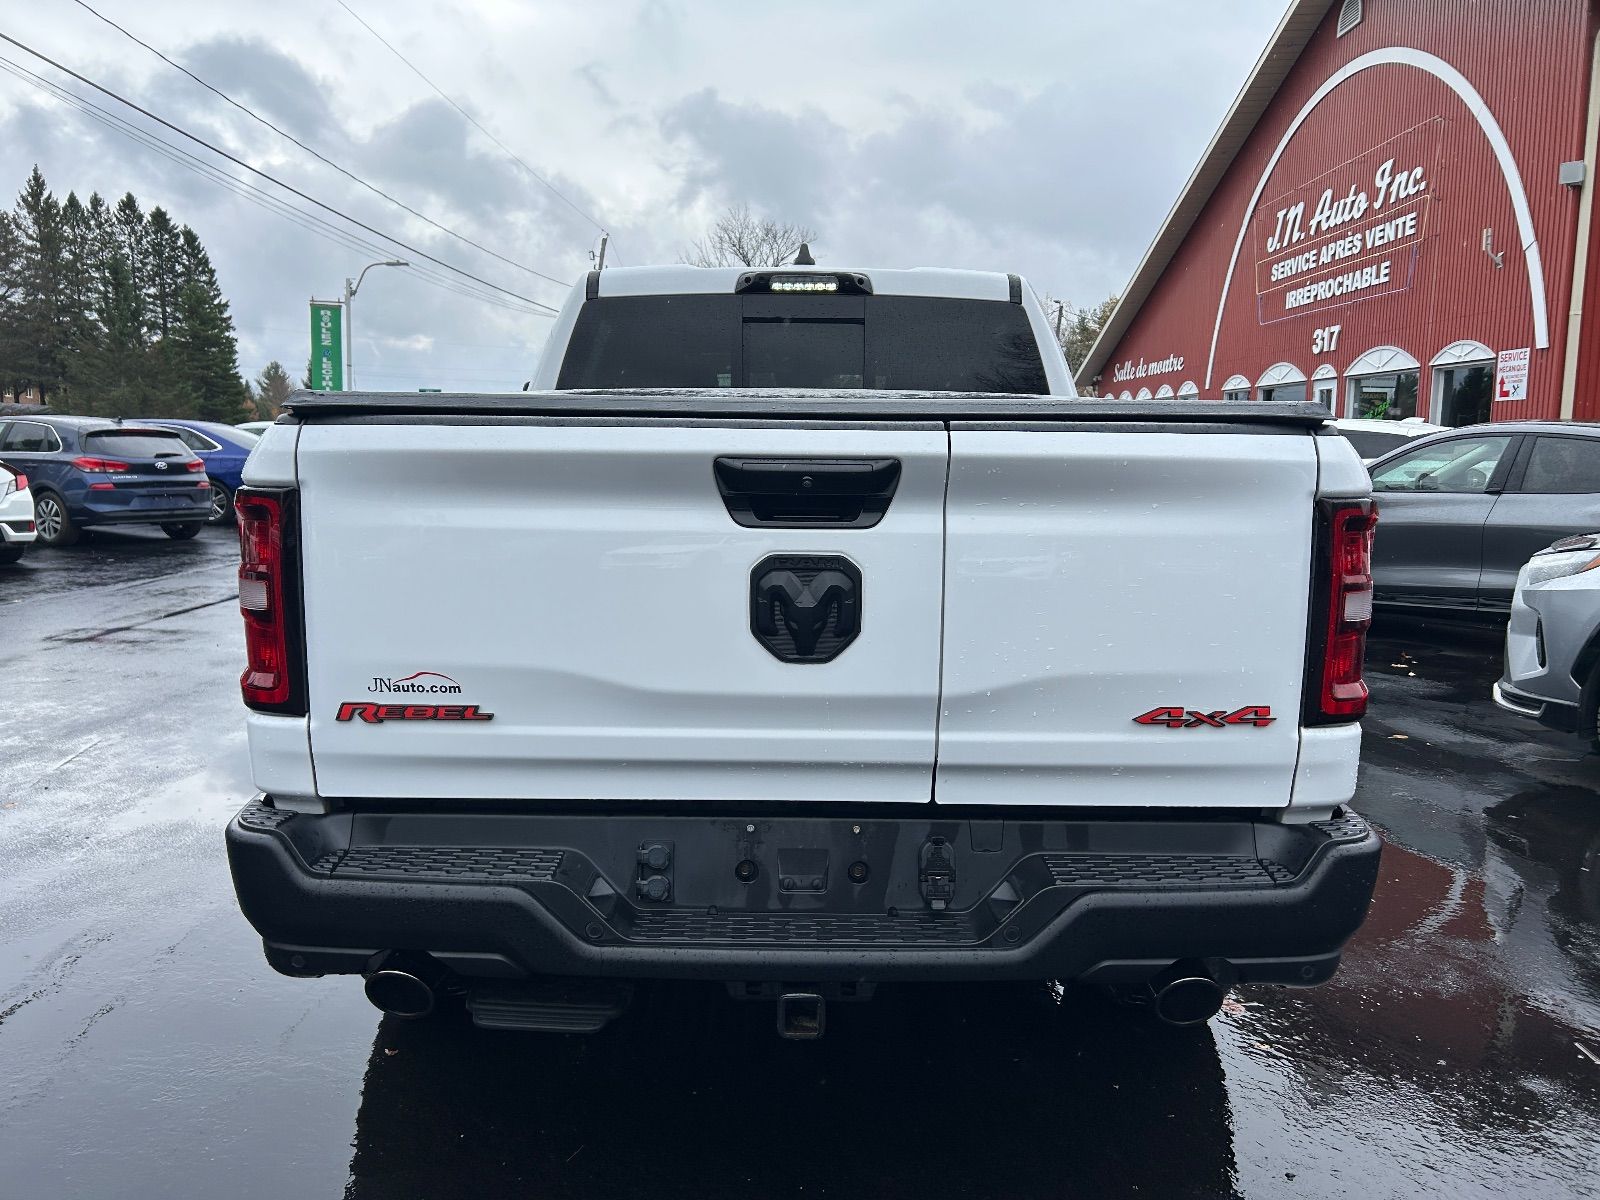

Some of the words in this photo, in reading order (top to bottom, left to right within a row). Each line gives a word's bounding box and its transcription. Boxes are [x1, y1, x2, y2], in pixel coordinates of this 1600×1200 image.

[1309, 184, 1369, 235] Auto
[1373, 158, 1427, 209] Inc.
[1270, 250, 1317, 282] SERVICE
[1319, 232, 1362, 266] APRÈS
[1365, 212, 1417, 249] VENTE
[1285, 261, 1391, 310] IRRÉPROCHABLE
[1312, 325, 1341, 355] 317
[1113, 360, 1135, 382] Salle
[1136, 357, 1147, 378] de
[1148, 353, 1184, 376] montre
[1500, 351, 1528, 363] SERVICE
[774, 557, 839, 569] RAM
[367, 677, 462, 693] JNauto.com
[335, 702, 495, 723] REBEL
